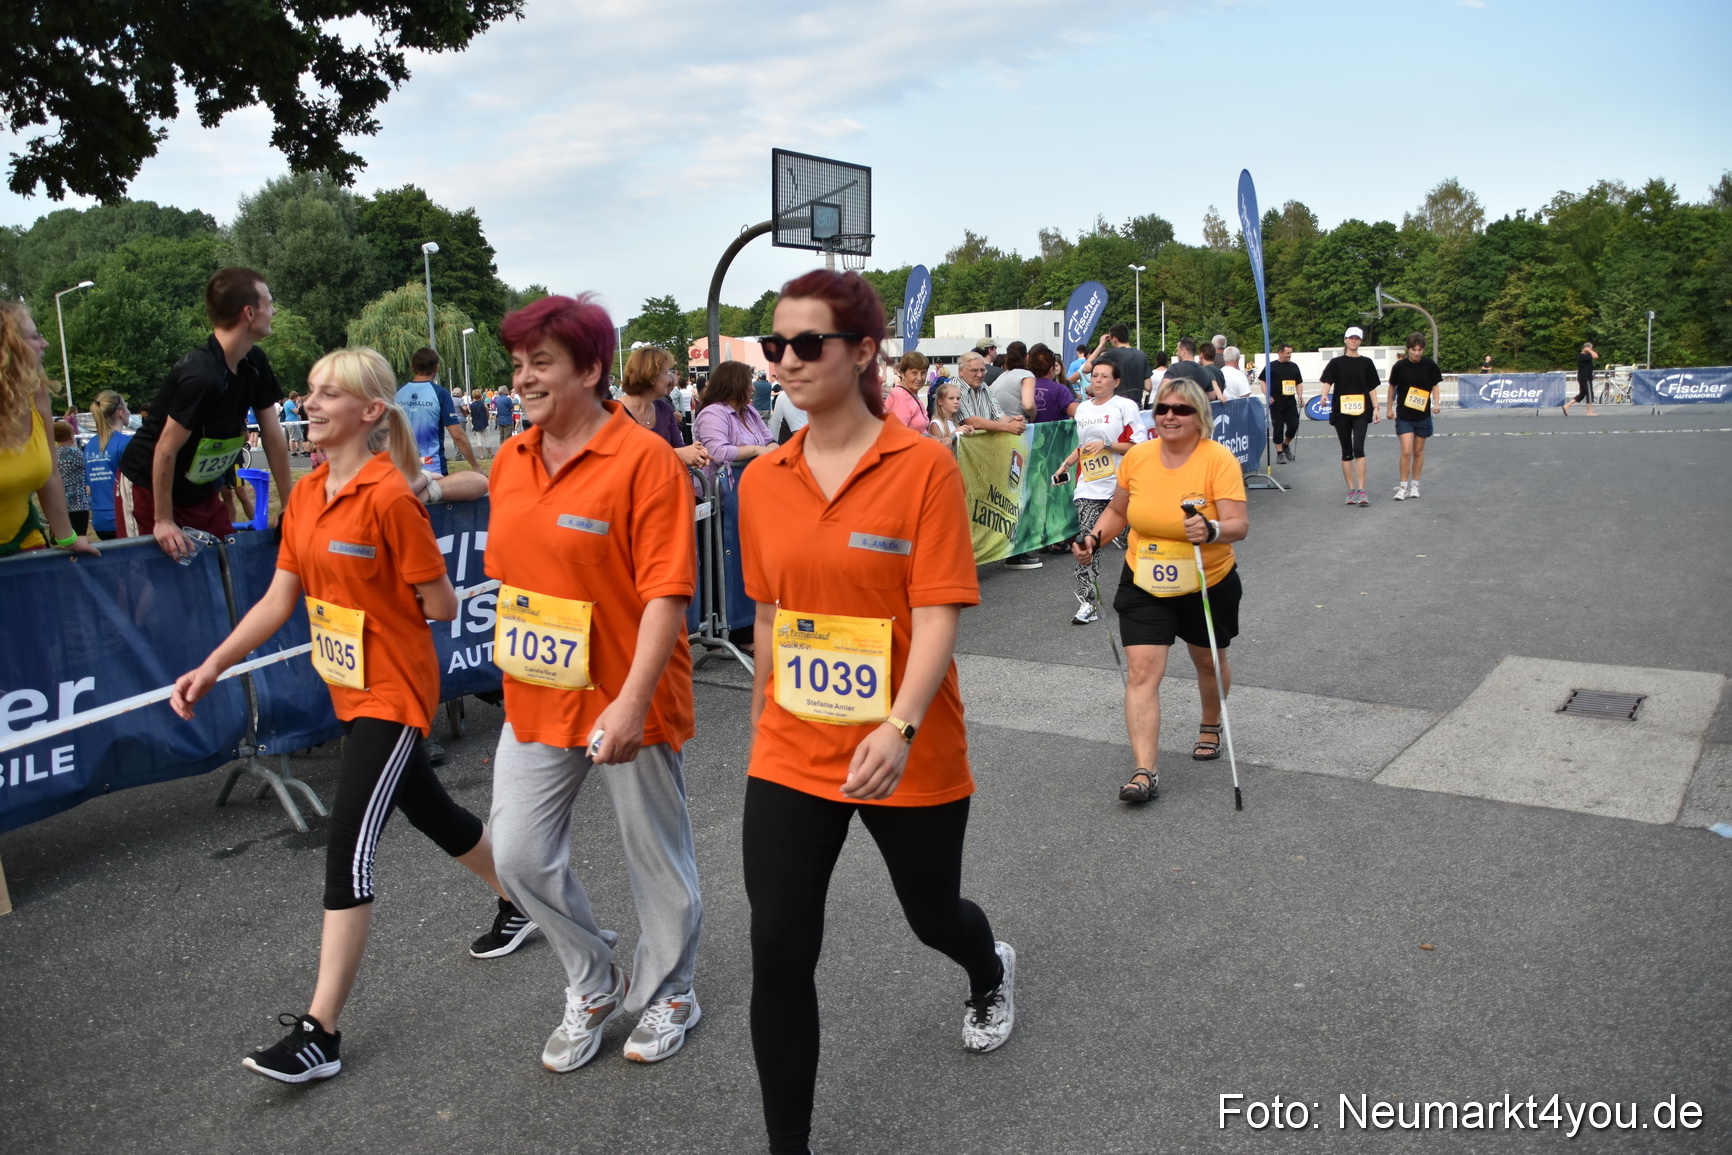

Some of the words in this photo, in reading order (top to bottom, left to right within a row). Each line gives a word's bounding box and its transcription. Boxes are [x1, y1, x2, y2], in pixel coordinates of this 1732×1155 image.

[1074, 290, 1098, 336] Fischer
[1490, 387, 1543, 399] Fischer
[1668, 381, 1727, 394] Fischer
[1408, 395, 1426, 406] 1265
[1672, 392, 1722, 400] AUTOMOBILE
[1343, 402, 1363, 411] 1255
[1083, 455, 1110, 472] 1510
[1153, 564, 1178, 583] 69
[316, 632, 356, 671] 1035
[506, 626, 578, 668] 1037
[787, 655, 878, 699] 1039
[806, 699, 833, 709] Stefanie
